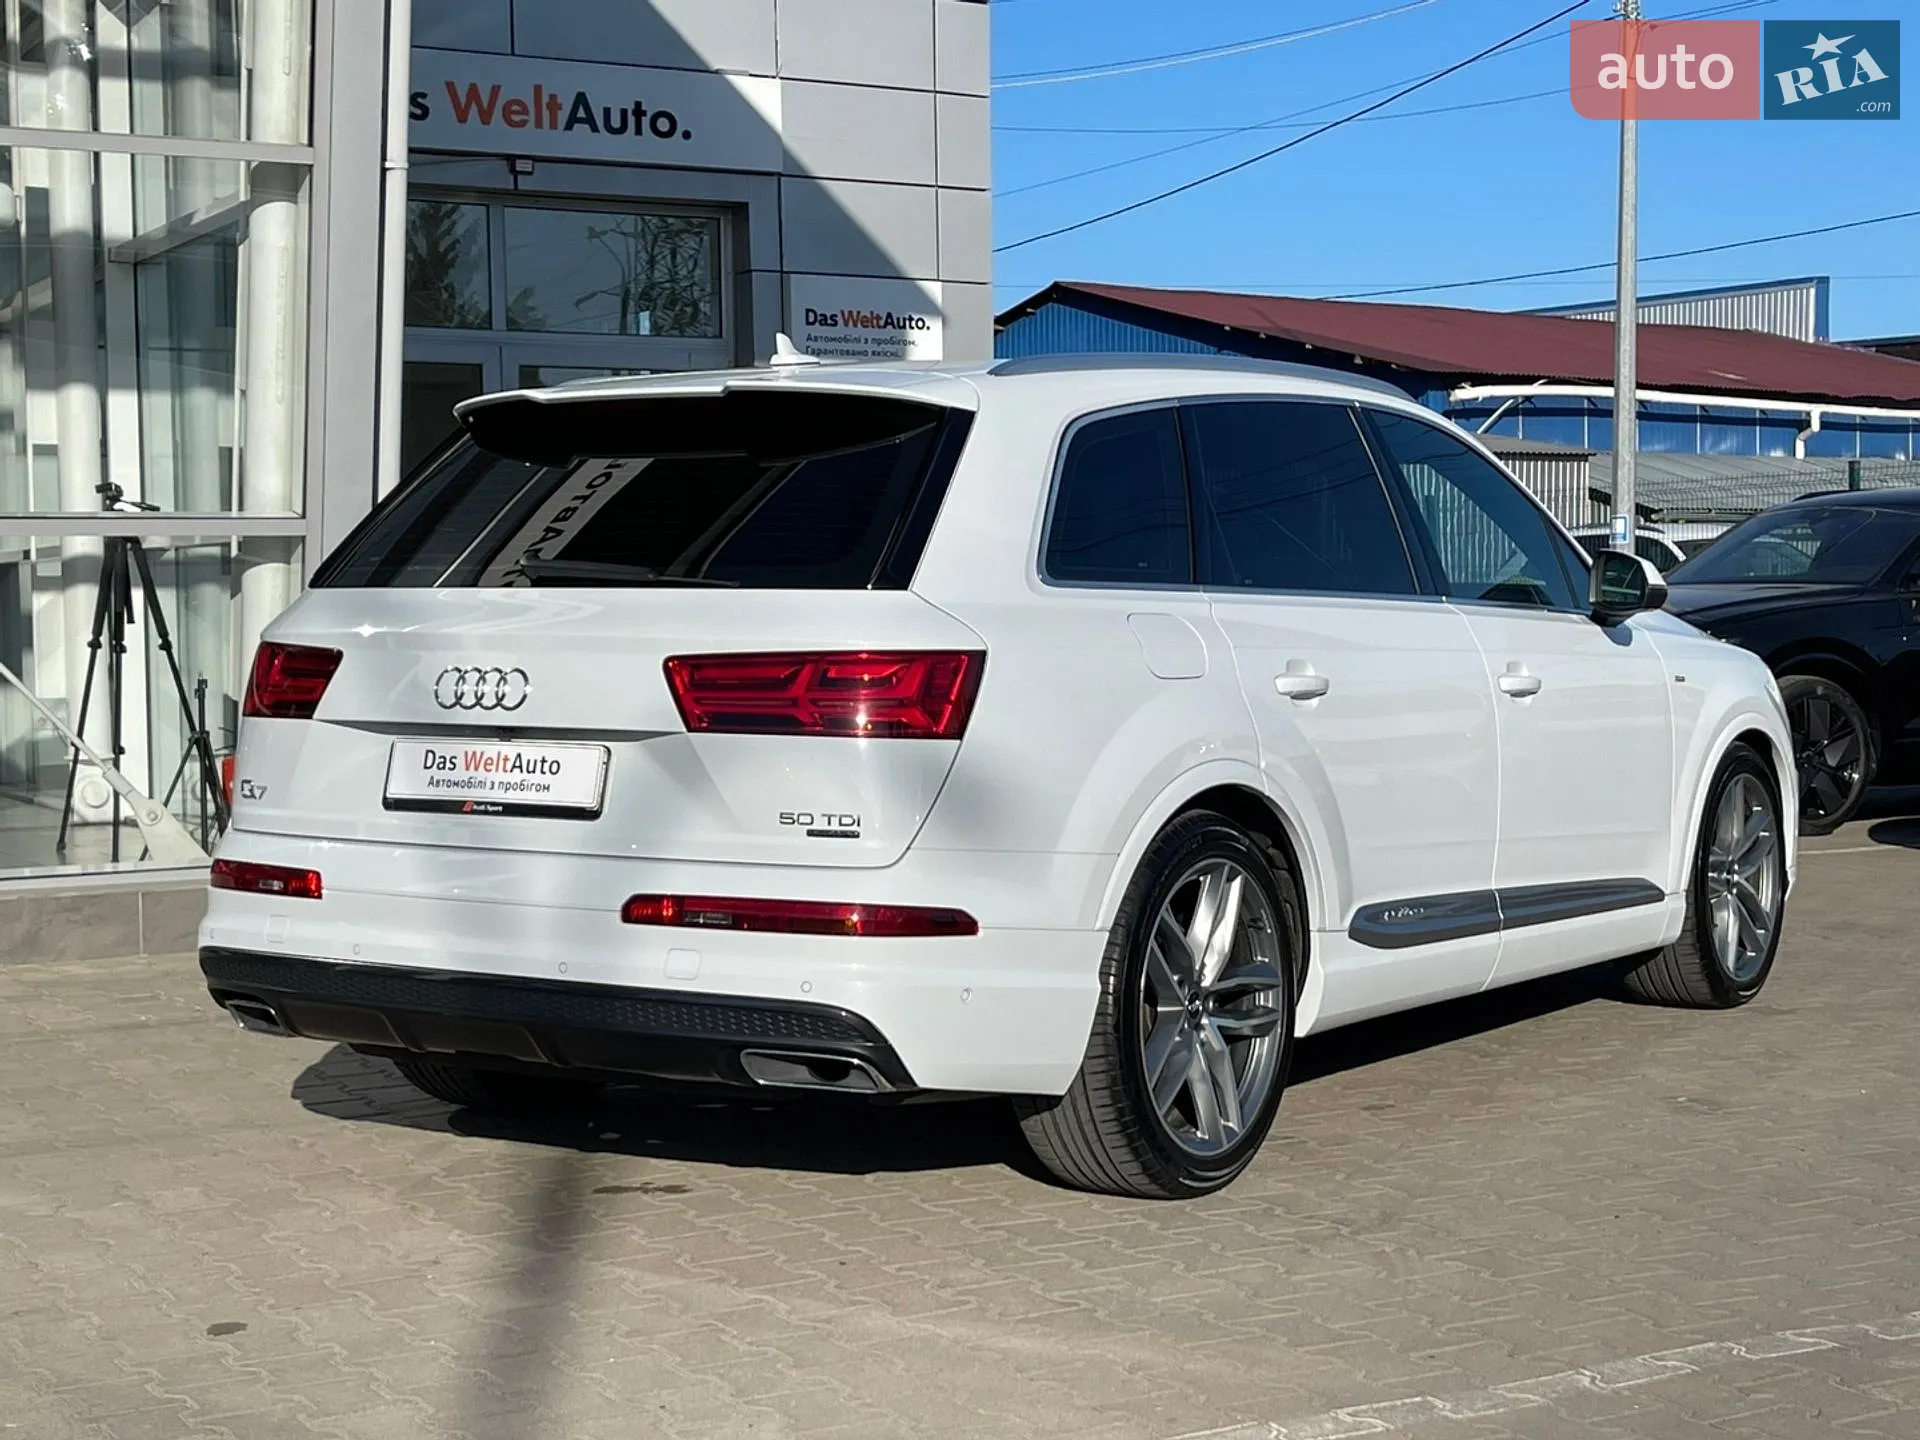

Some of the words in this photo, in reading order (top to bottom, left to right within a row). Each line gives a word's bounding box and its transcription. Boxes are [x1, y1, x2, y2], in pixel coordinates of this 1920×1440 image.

[445, 80, 693, 141] WeltAuto.
[805, 308, 839, 327] Das
[840, 310, 931, 331] WeltAuto.
[806, 333, 861, 345] Автомобілі
[423, 749, 458, 771] Das
[463, 750, 561, 776] WeltAuto
[241, 779, 268, 800] Q7
[427, 775, 488, 790] Автомобілі
[489, 781, 496, 791] з
[497, 779, 551, 794] пробігом
[779, 812, 815, 826] 50
[821, 813, 860, 827] TDI
